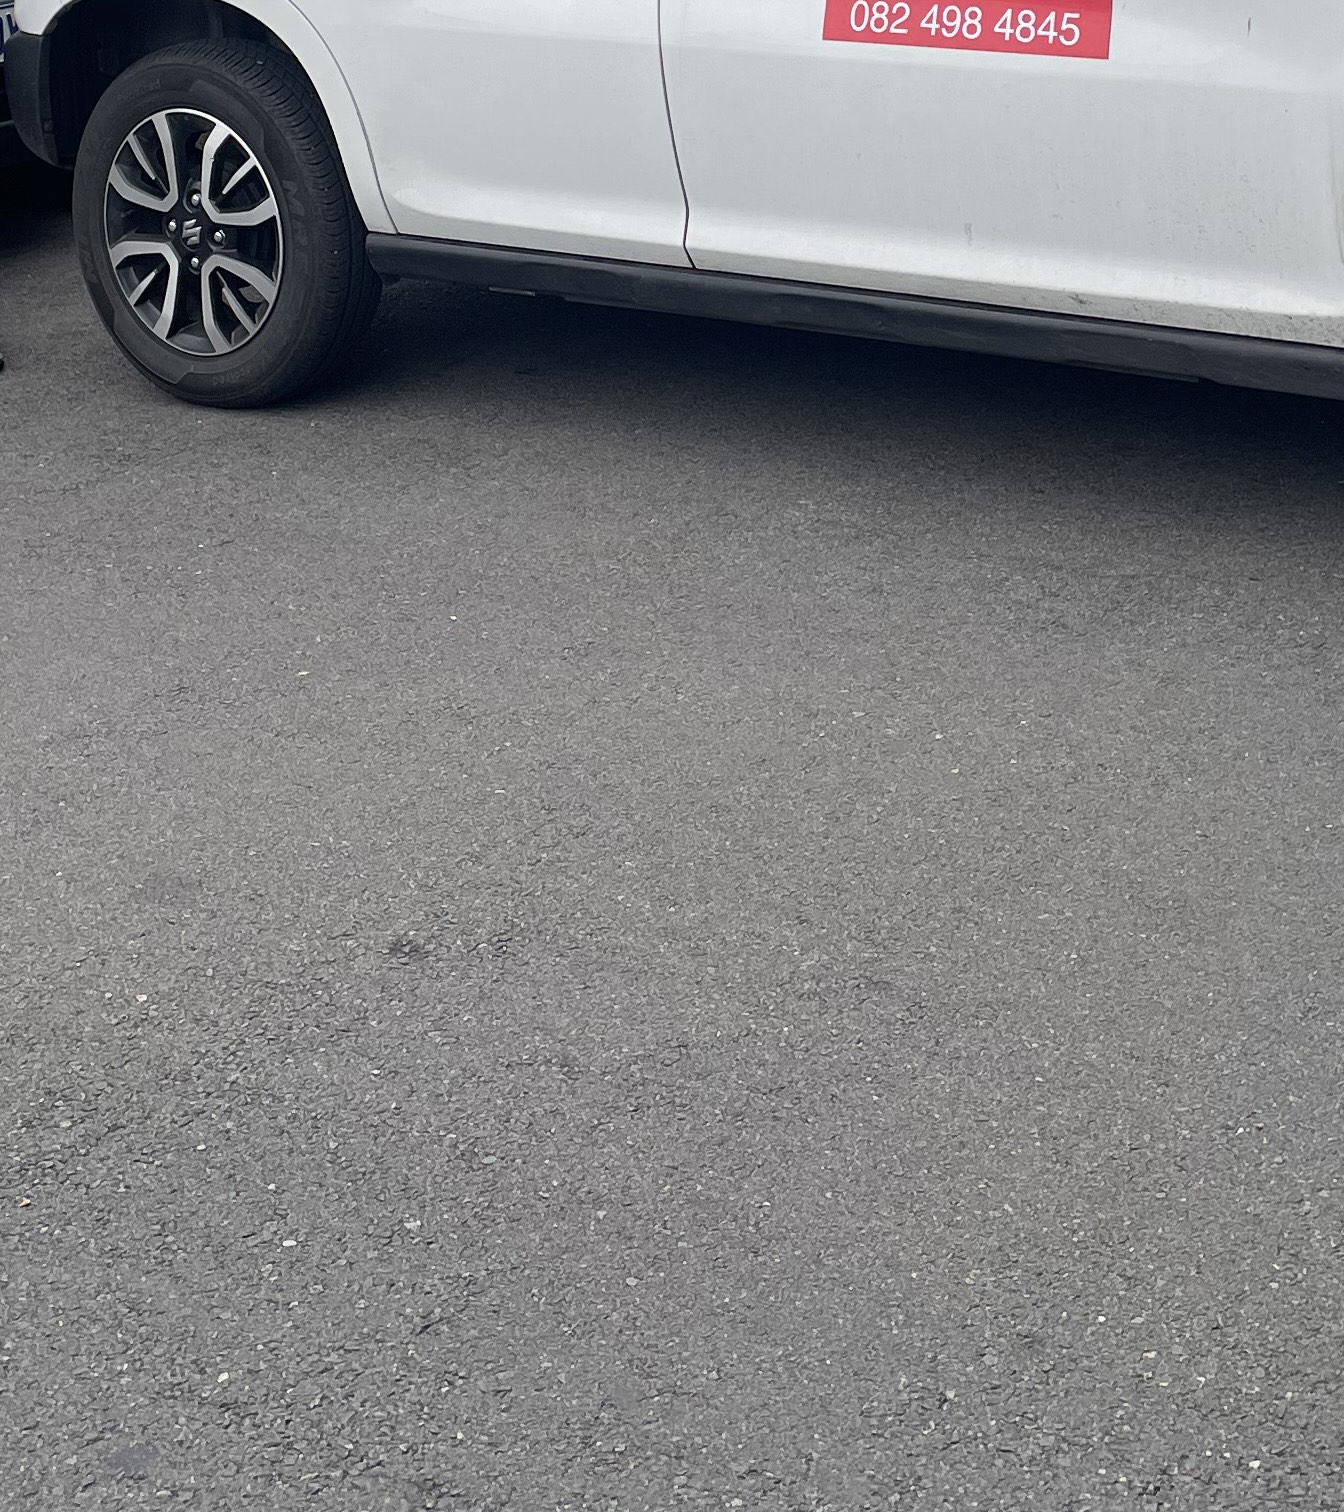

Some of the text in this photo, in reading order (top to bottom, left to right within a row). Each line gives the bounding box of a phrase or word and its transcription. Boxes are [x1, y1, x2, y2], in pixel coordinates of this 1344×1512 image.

[850, 0, 1081, 46] 082 498 4845
